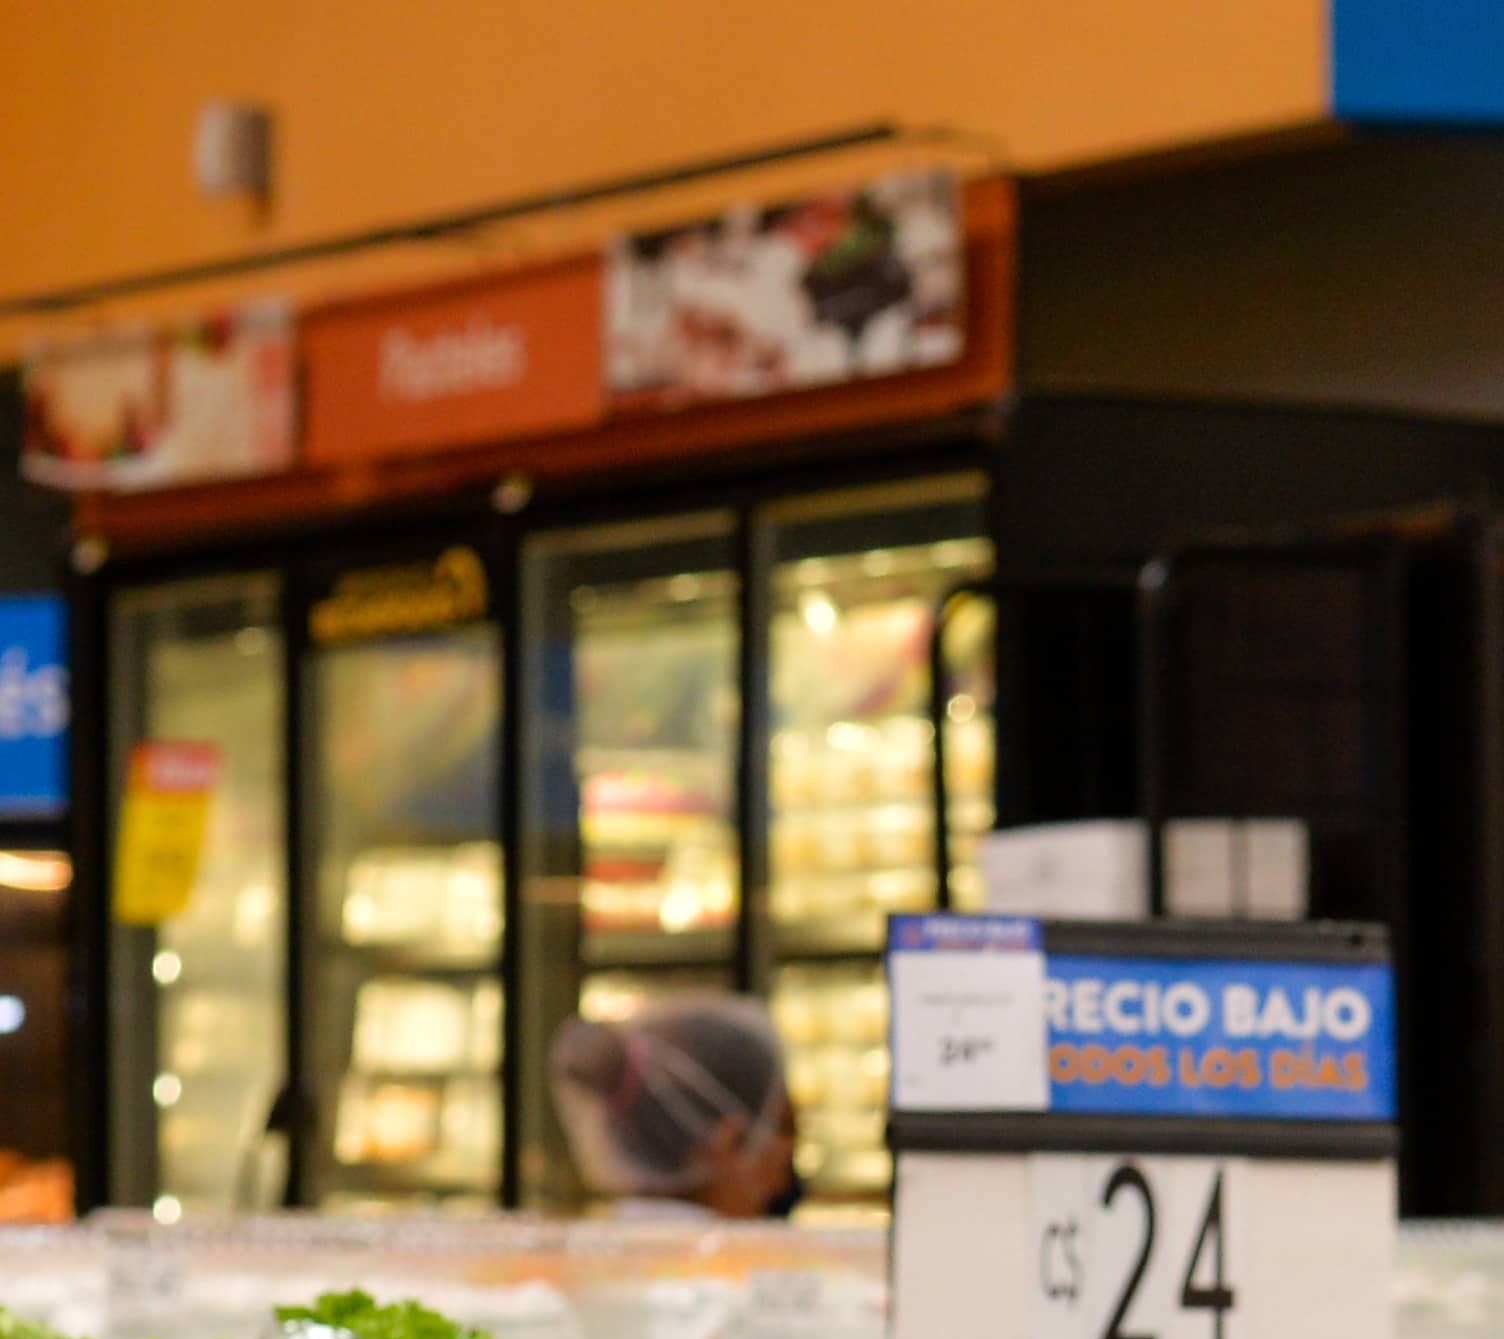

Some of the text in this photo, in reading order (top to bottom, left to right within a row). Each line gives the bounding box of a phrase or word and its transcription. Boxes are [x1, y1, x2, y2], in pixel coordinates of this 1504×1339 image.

[1044, 977, 1371, 1041] RECIO BAJO
[1049, 1036, 1368, 1092] ODOS LOS DÍAS
